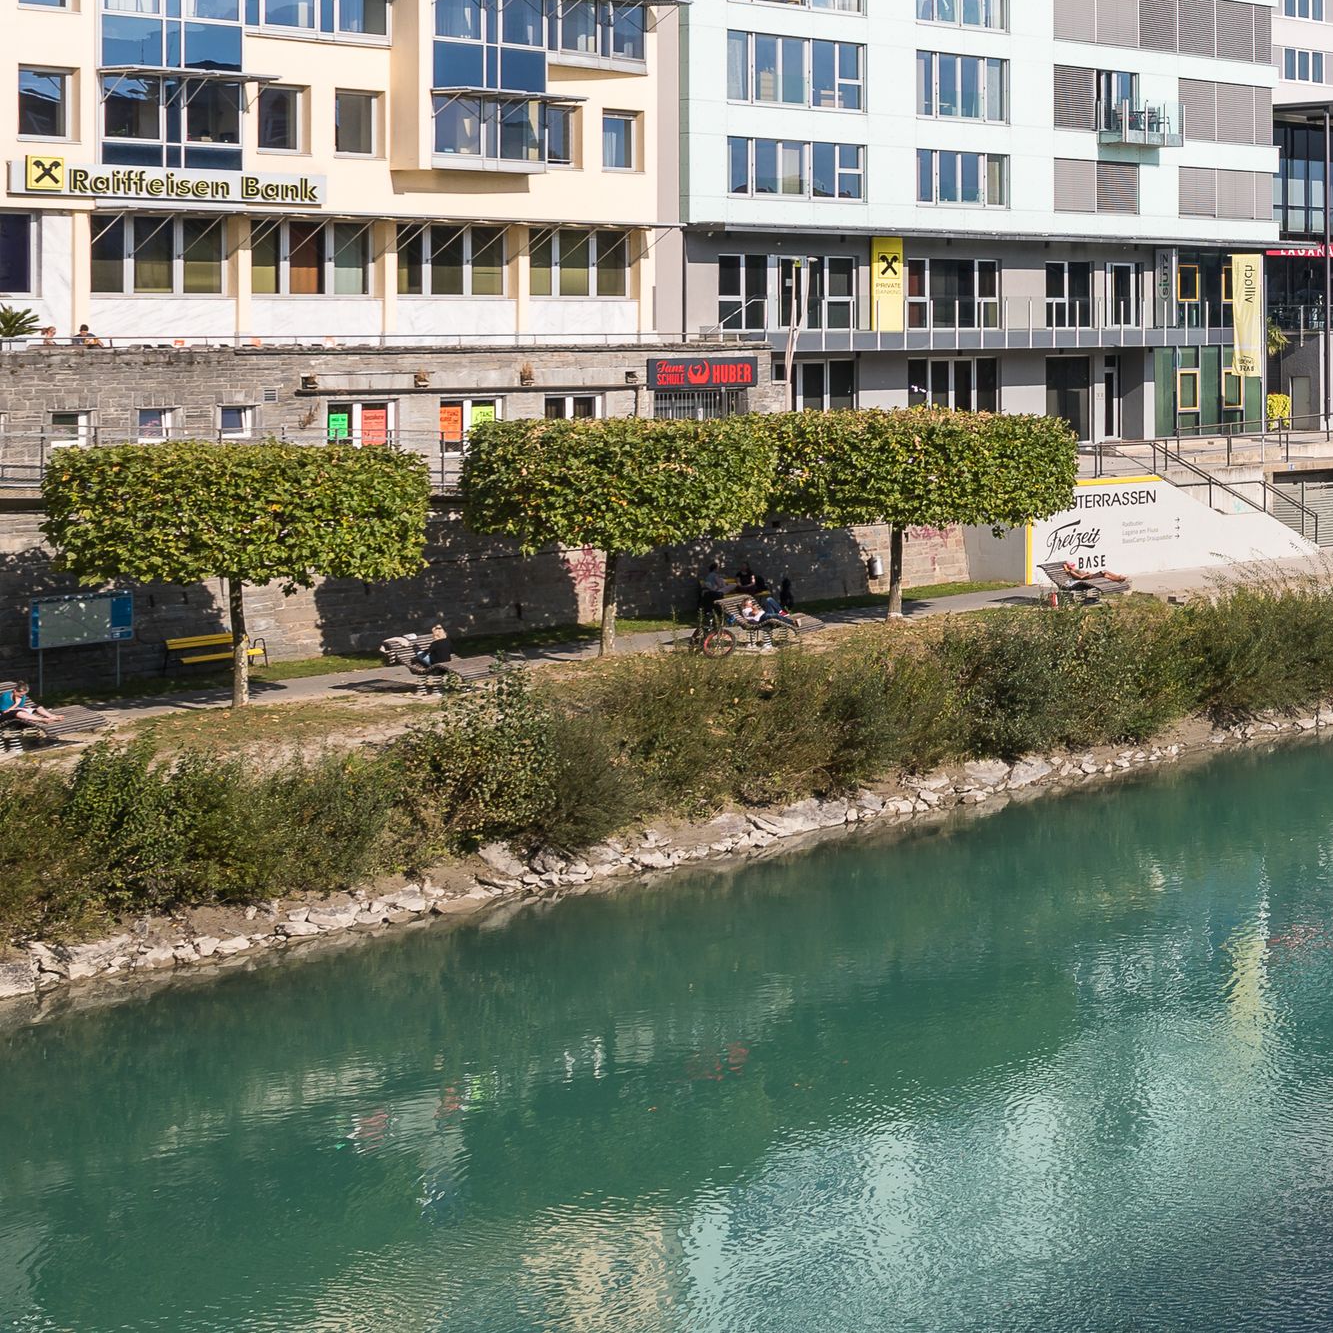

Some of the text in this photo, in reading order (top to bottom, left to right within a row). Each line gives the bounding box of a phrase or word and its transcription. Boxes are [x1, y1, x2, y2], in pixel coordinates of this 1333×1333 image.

[69, 168, 319, 202] Raiffeisen Bank
[657, 373, 685, 386] SCHULE
[712, 363, 752, 383] HUBER
[1067, 490, 1157, 510] UTERRASSEN
[1045, 519, 1101, 561] Freizeit
[1078, 555, 1106, 569] BASE
